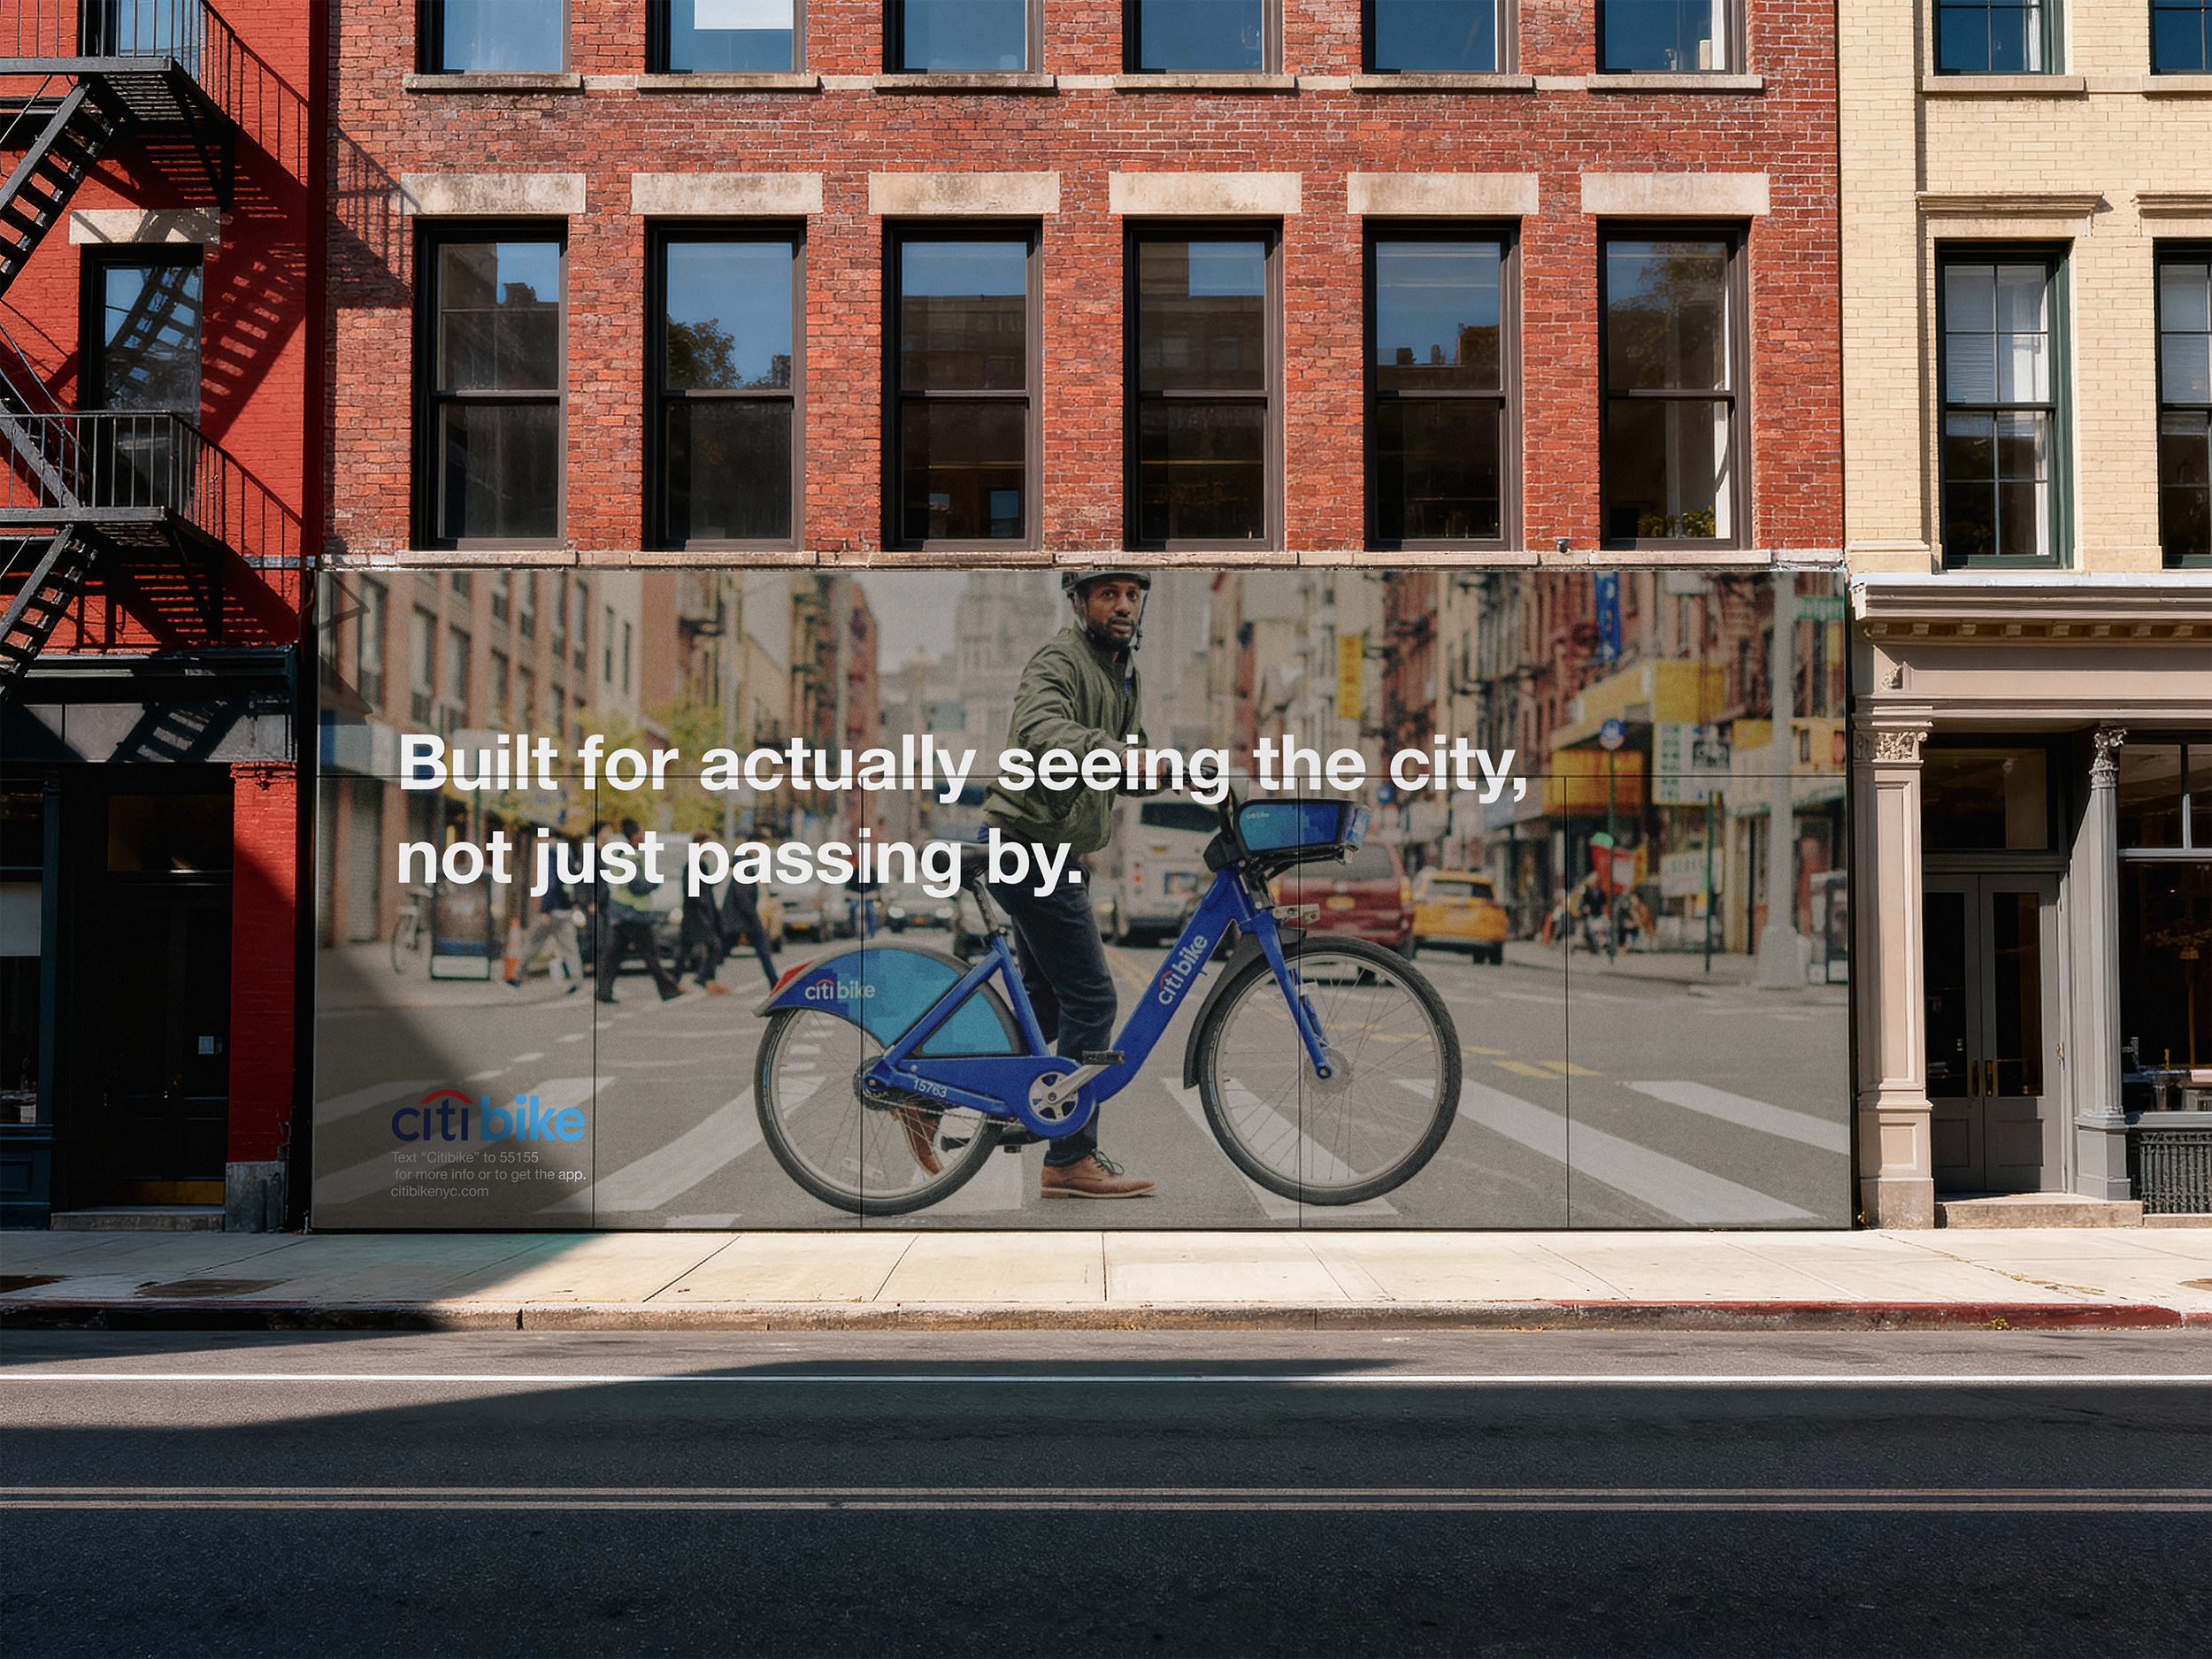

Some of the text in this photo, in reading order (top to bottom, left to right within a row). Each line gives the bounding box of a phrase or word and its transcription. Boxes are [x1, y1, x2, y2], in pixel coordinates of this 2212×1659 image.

[400, 733, 1527, 804] Built for actually seeing the city,
[398, 827, 1082, 898] not just passing by.
[1158, 935, 1208, 1005] citi bike
[805, 979, 876, 1001] citi bike
[913, 1076, 948, 1098] 15763
[391, 1089, 587, 1141] citi bike
[391, 1151, 418, 1164] Text
[483, 1152, 496, 1164] to
[499, 1151, 539, 1164] 55155
[395, 1168, 588, 1183] for more info or to get the app.
[390, 1185, 489, 1200] citibikenyc.com
